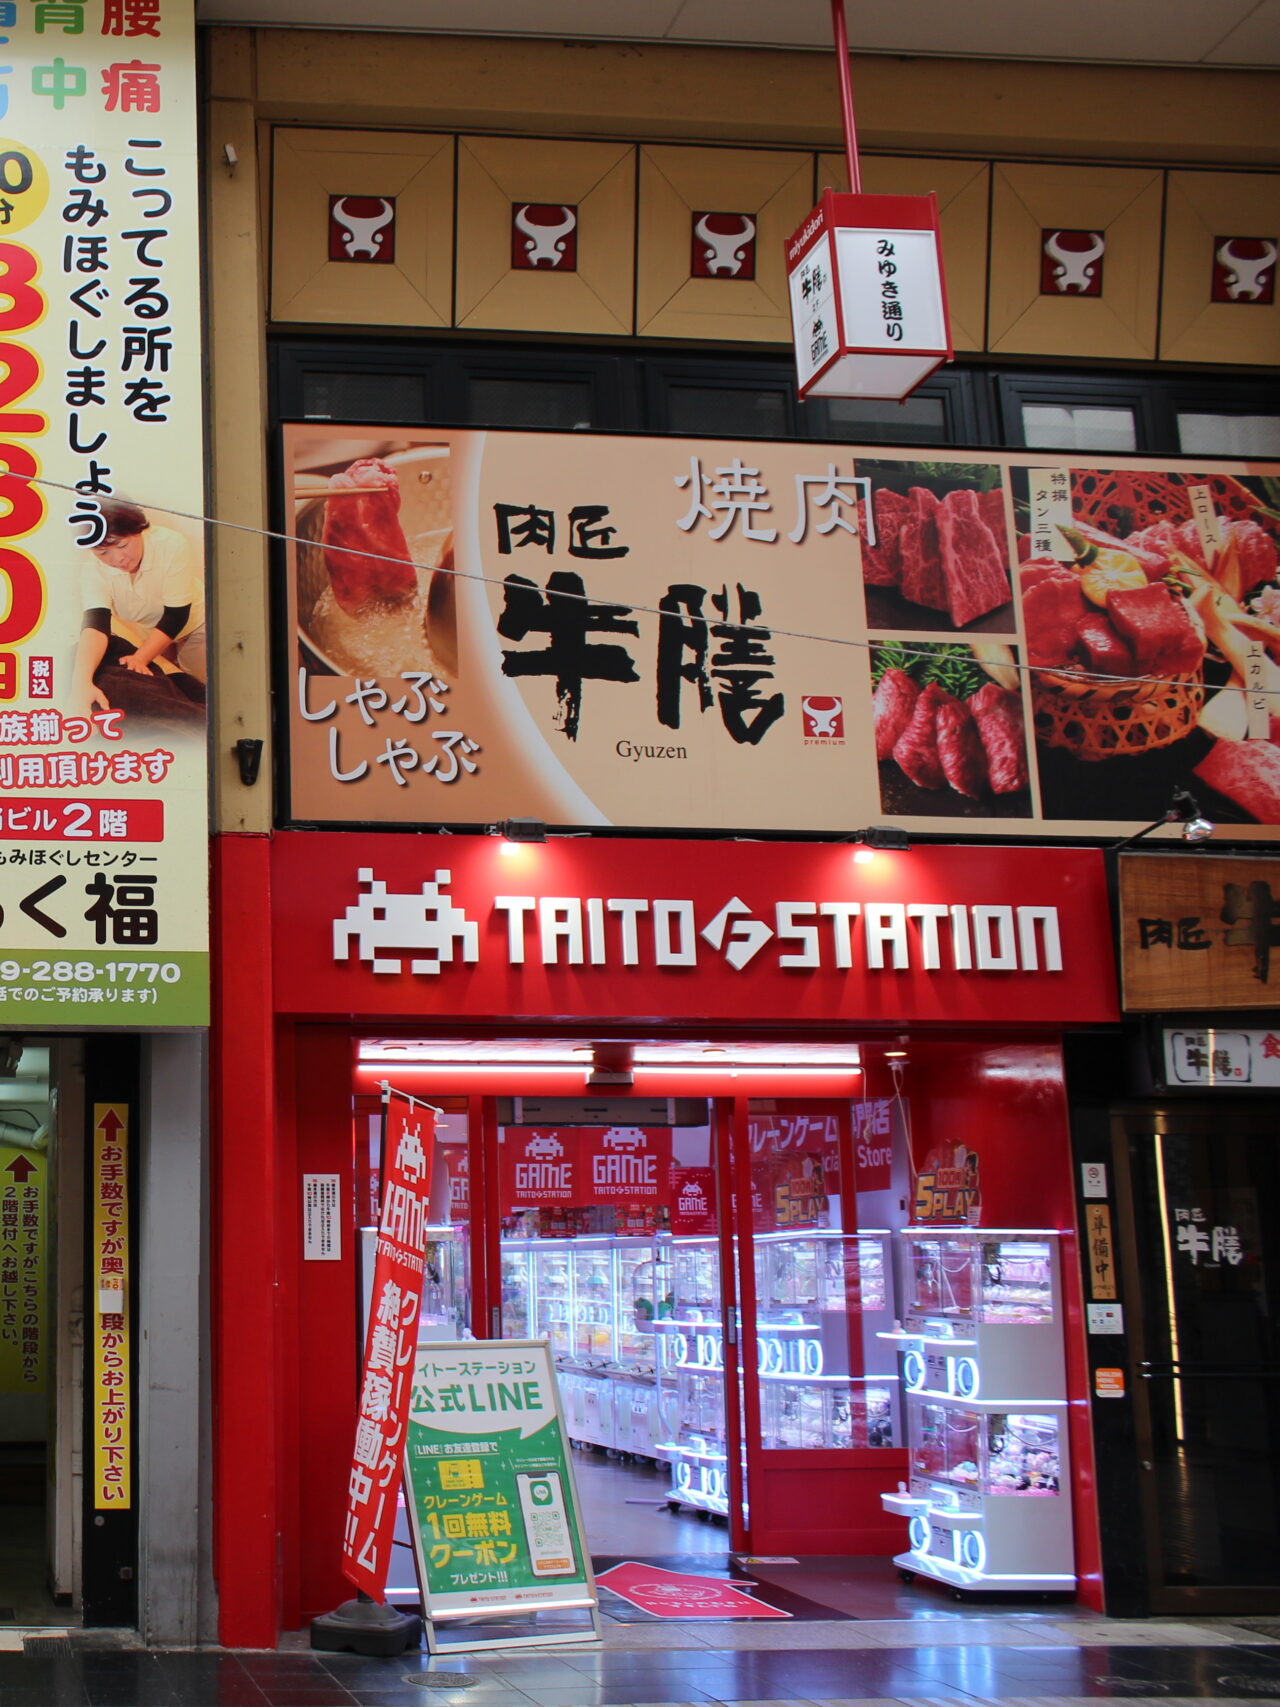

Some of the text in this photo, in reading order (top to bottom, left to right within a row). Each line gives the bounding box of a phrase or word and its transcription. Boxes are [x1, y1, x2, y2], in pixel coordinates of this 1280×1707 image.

[101, 0, 162, 113] 腰痛
[120, 139, 173, 422] こってる所を
[877, 239, 903, 342] みゆき通り
[62, 145, 112, 547] もみほぐしましょう
[493, 502, 630, 560] 肉匠
[674, 455, 877, 548] 焼肉
[1035, 490, 1052, 552] タン三種
[1193, 489, 1218, 545] 上ロース
[32, 660, 50, 696] 税込
[497, 570, 785, 745] 牛膳
[1246, 645, 1266, 712] 上カルビ
[298, 665, 449, 726] しゃぶ
[328, 725, 481, 787] しゃぶ
[616, 740, 688, 760] Gyuzen
[494, 895, 697, 966] TAITO
[775, 901, 1063, 971] STATION
[516, 1163, 572, 1190] GAME
[593, 1155, 657, 1184] GAME
[857, 1144, 892, 1168] Store
[678, 1197, 708, 1211] GAME
[22, 1186, 39, 1384] お手数ですがこちらの階段から
[413, 1361, 536, 1380] イトーステーション
[356, 1291, 419, 1575] クレーンゲーム
[423, 1492, 508, 1509] クレーンゲーム
[426, 1510, 512, 1540] 1回無料
[429, 1542, 517, 1569] クーポン
